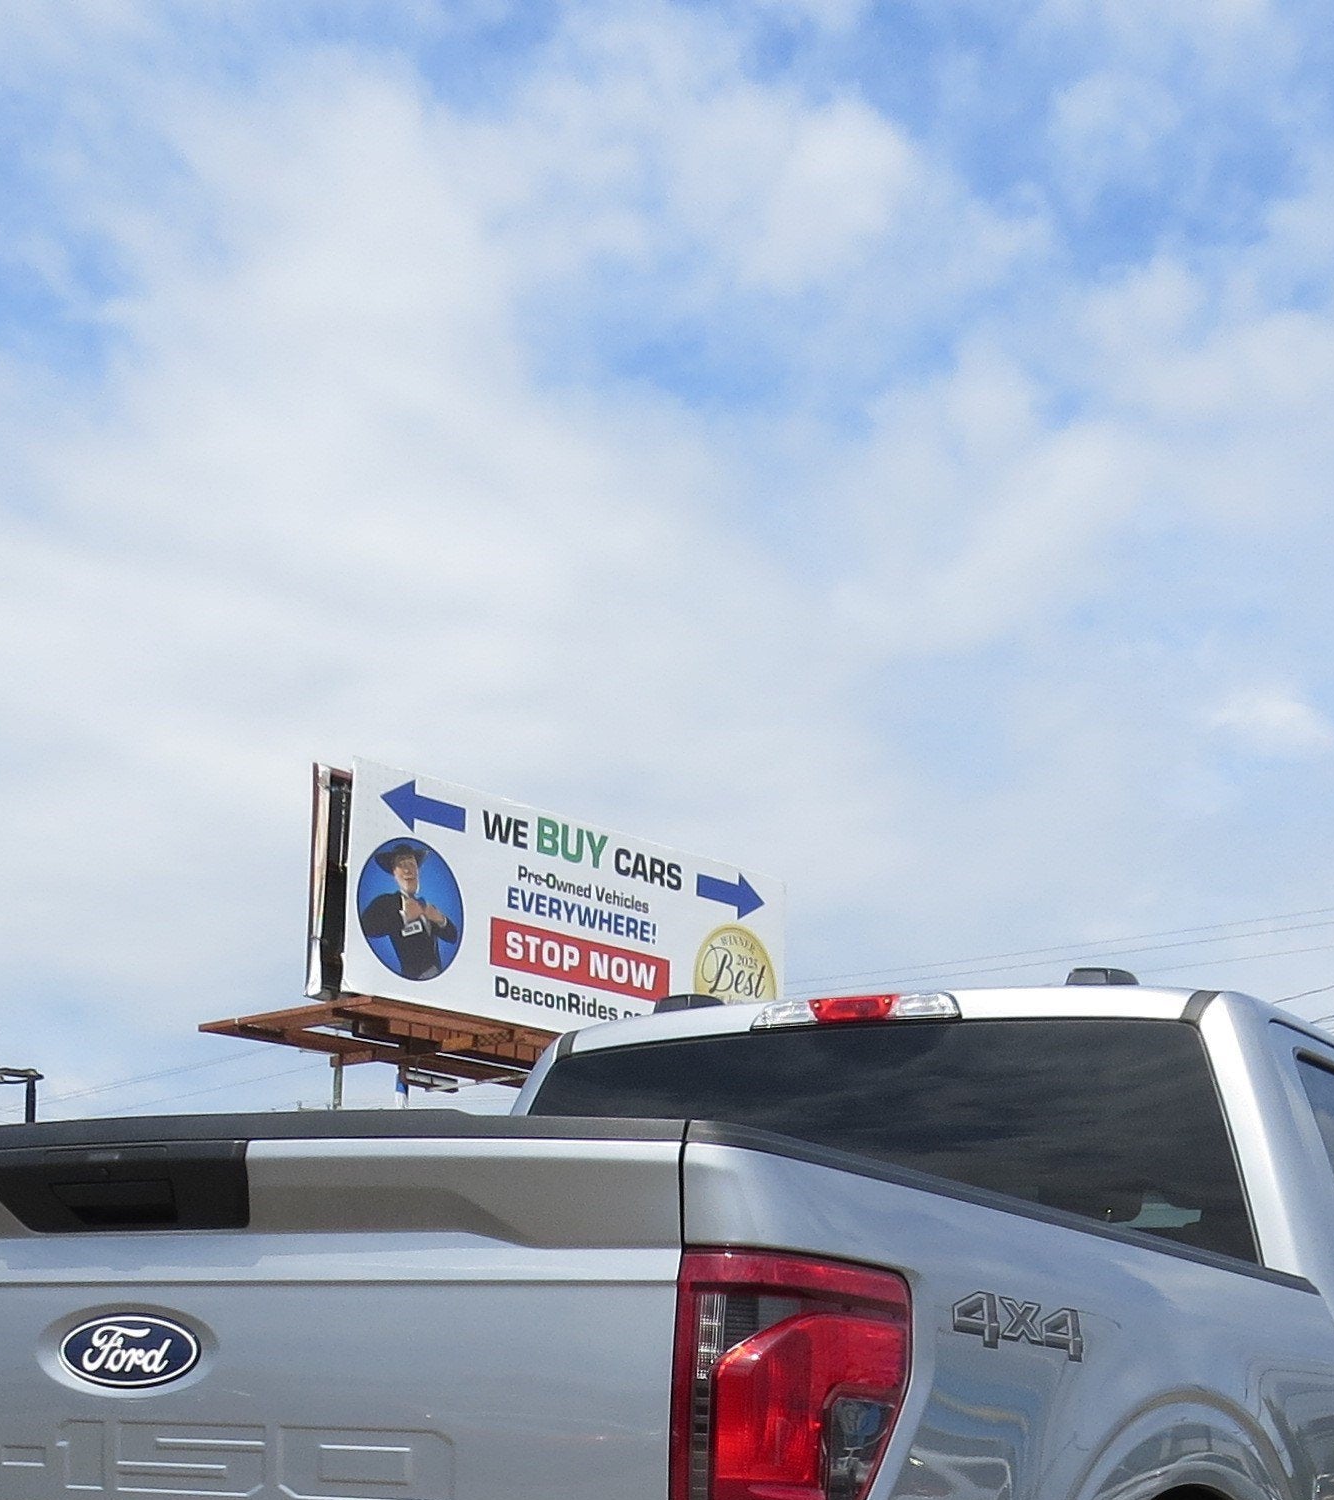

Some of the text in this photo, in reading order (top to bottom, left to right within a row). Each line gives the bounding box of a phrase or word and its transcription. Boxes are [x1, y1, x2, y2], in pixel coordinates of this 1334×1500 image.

[482, 809, 682, 891] WE BUY CARS
[507, 886, 657, 944] EVERYWHERE!
[518, 864, 649, 914] Pre-Owned Vehicles
[505, 931, 656, 991] STOP NOW
[701, 944, 766, 999] Best
[82, 1324, 172, 1374] Ford
